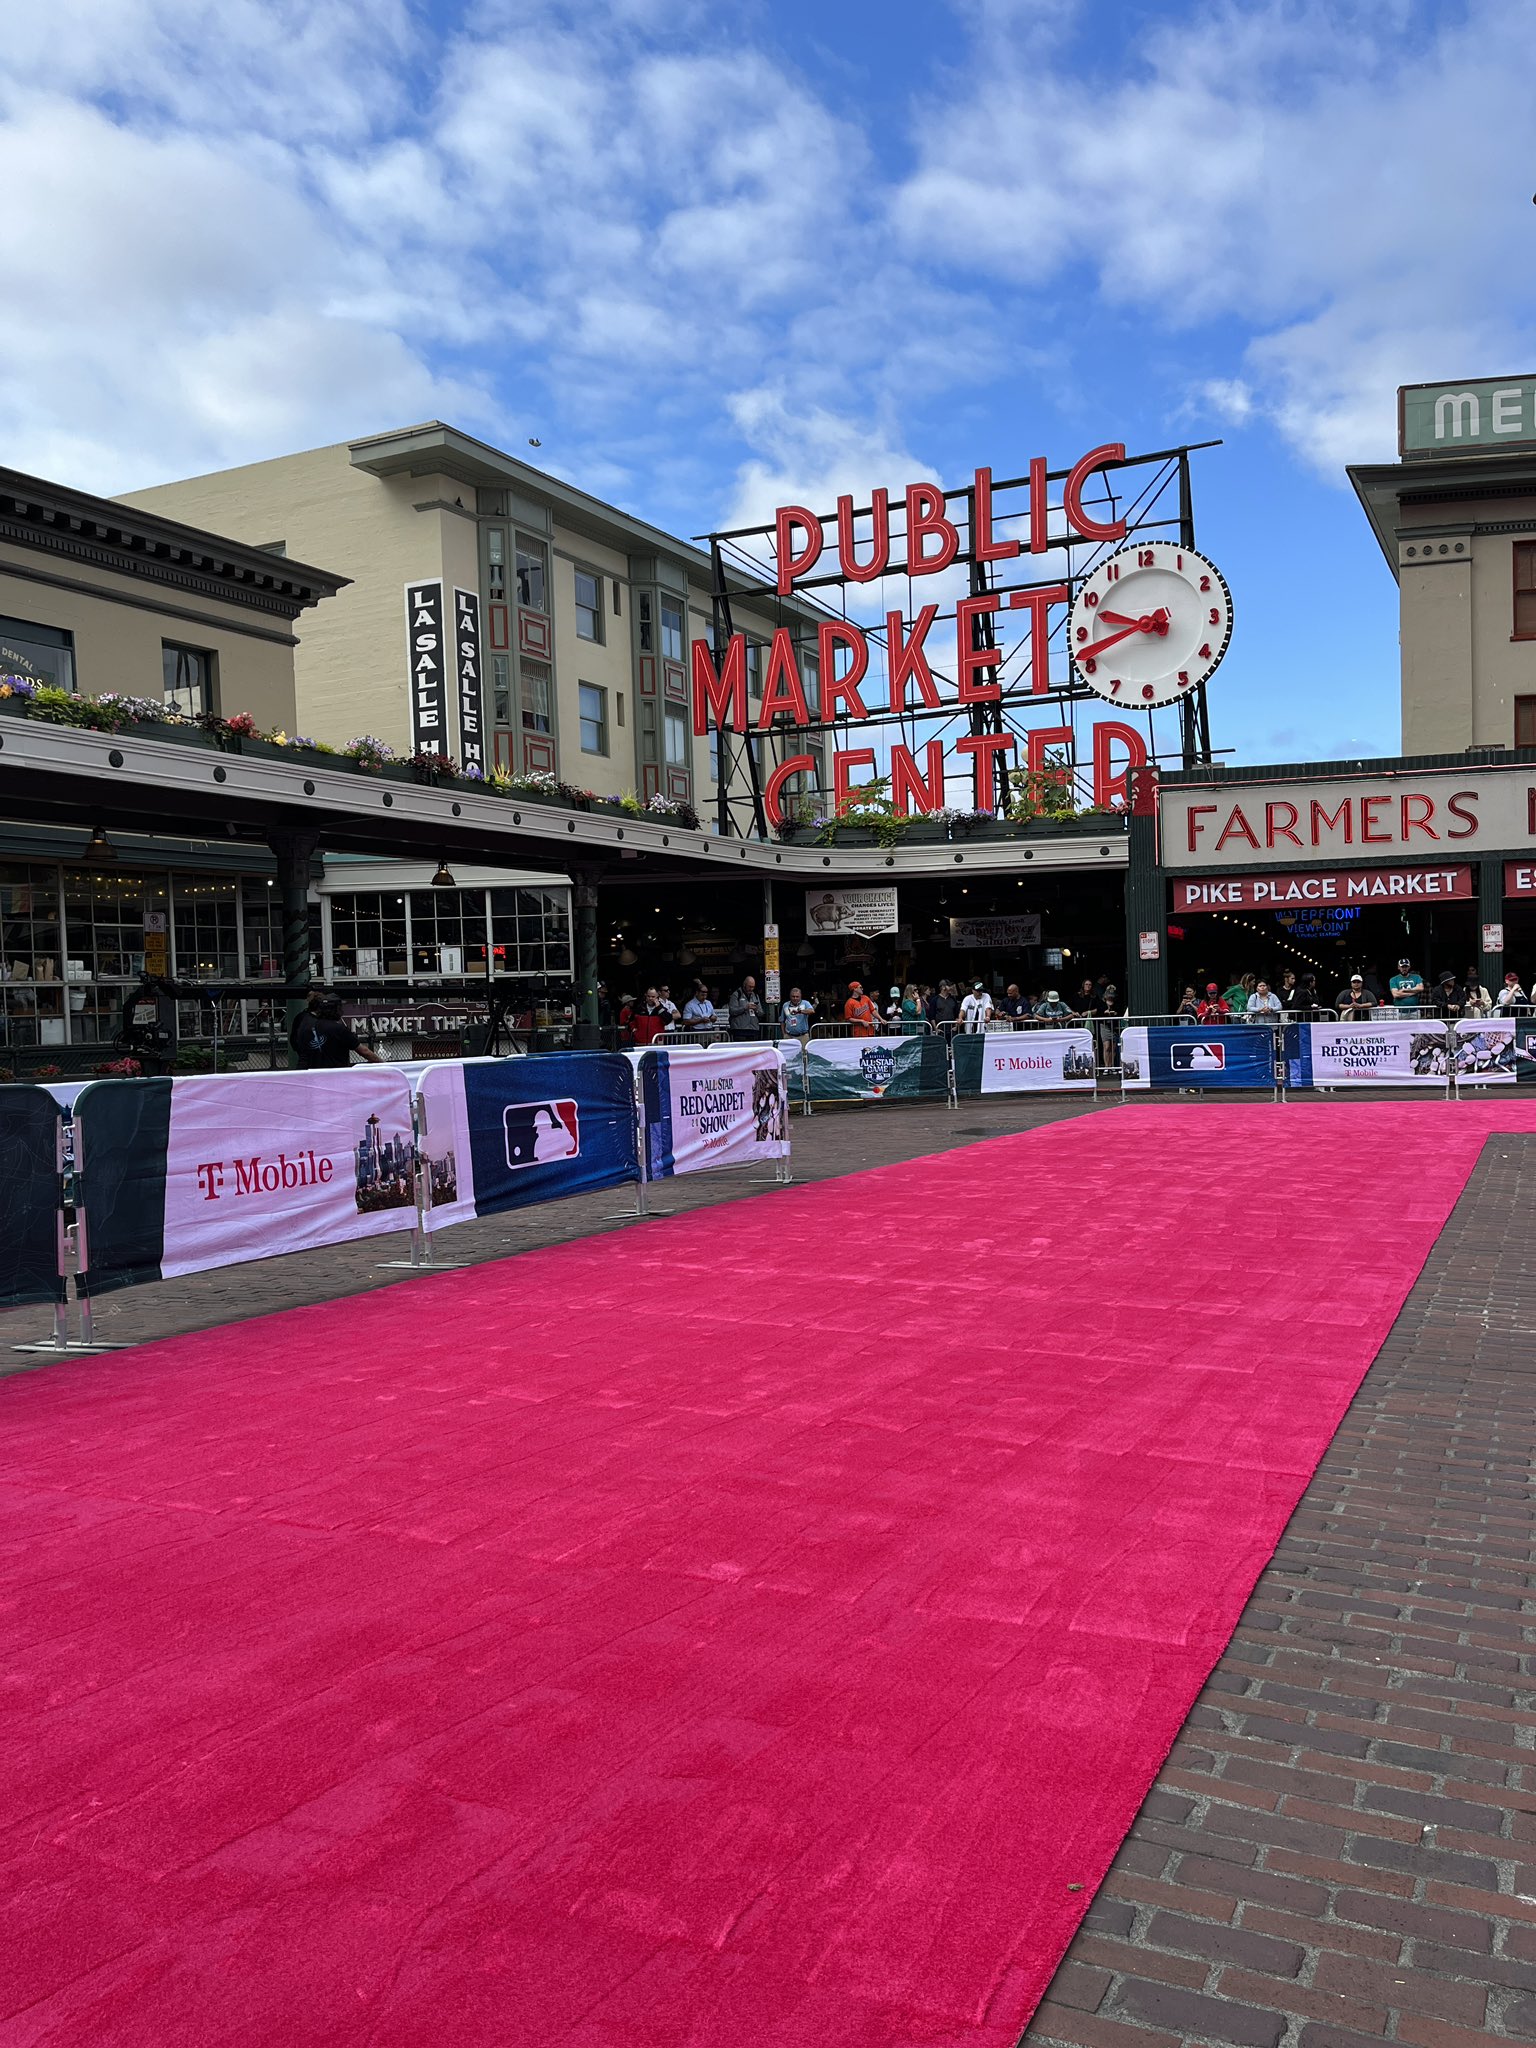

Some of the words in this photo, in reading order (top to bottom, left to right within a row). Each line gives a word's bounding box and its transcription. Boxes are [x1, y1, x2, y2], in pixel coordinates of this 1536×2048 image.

[1434, 388, 1536, 440] ME
[775, 442, 1127, 597] PUBLIC
[1138, 550, 1154, 567] 12
[1176, 554, 1182, 571] 1
[1107, 564, 1119, 581] 11
[1199, 575, 1211, 592] 2
[1084, 591, 1099, 608] 10
[413, 591, 436, 628] LA
[458, 594, 476, 633] LA
[1208, 608, 1220, 625] 3
[1076, 626, 1088, 642] 9
[1, 647, 33, 673] DENTAL
[1198, 643, 1212, 660] 4
[690, 585, 1069, 737] MARKET
[1085, 658, 1097, 674] 8
[415, 633, 439, 728] SALLE
[461, 641, 478, 733] SALLE
[1110, 679, 1122, 695] 7
[1177, 671, 1189, 687] 5
[1141, 684, 1154, 700] 6
[764, 721, 1148, 828] CENTER
[1187, 790, 1479, 852] FARMERS
[1185, 882, 1242, 904] PIKE
[1253, 878, 1337, 901] PLACE
[1347, 871, 1458, 897] MARKET
[842, 893, 862, 904] YOUR
[864, 892, 895, 903] CHANGE
[351, 1016, 425, 1033] MARKET
[1321, 1045, 1348, 1057] RED
[1349, 1045, 1400, 1056] CARPET
[1343, 1057, 1378, 1067] SHOW
[680, 1095, 704, 1116] RED
[704, 1092, 745, 1113] CARPET
[700, 1114, 729, 1135] SHOW
